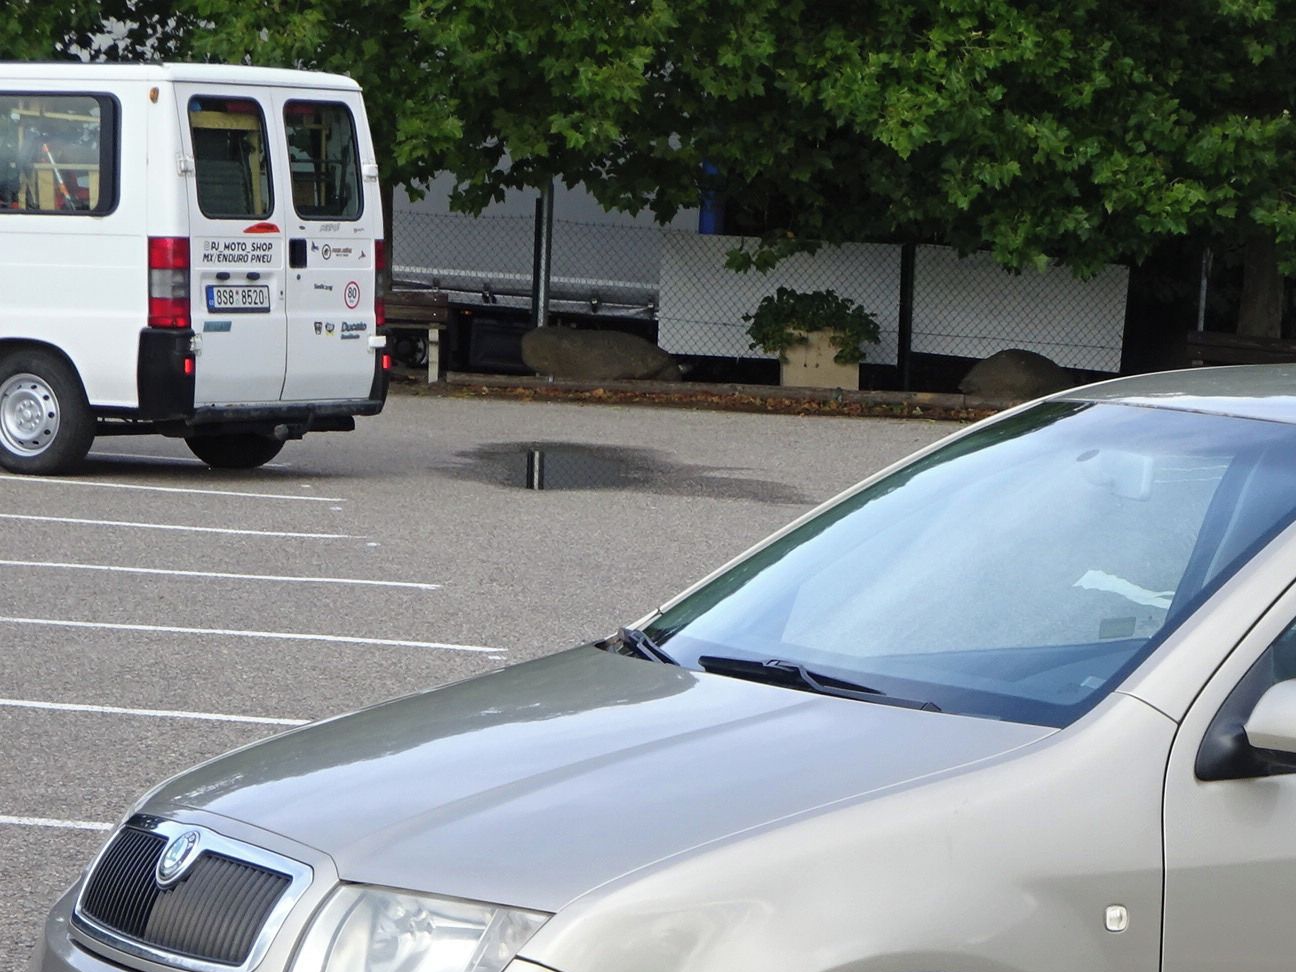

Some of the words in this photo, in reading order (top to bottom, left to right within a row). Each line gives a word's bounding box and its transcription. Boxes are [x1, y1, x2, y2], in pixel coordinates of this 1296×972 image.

[250, 254, 272, 264] PNEU
[216, 289, 234, 305] 8S8
[241, 289, 265, 305] 8520
[347, 286, 357, 299] 80
